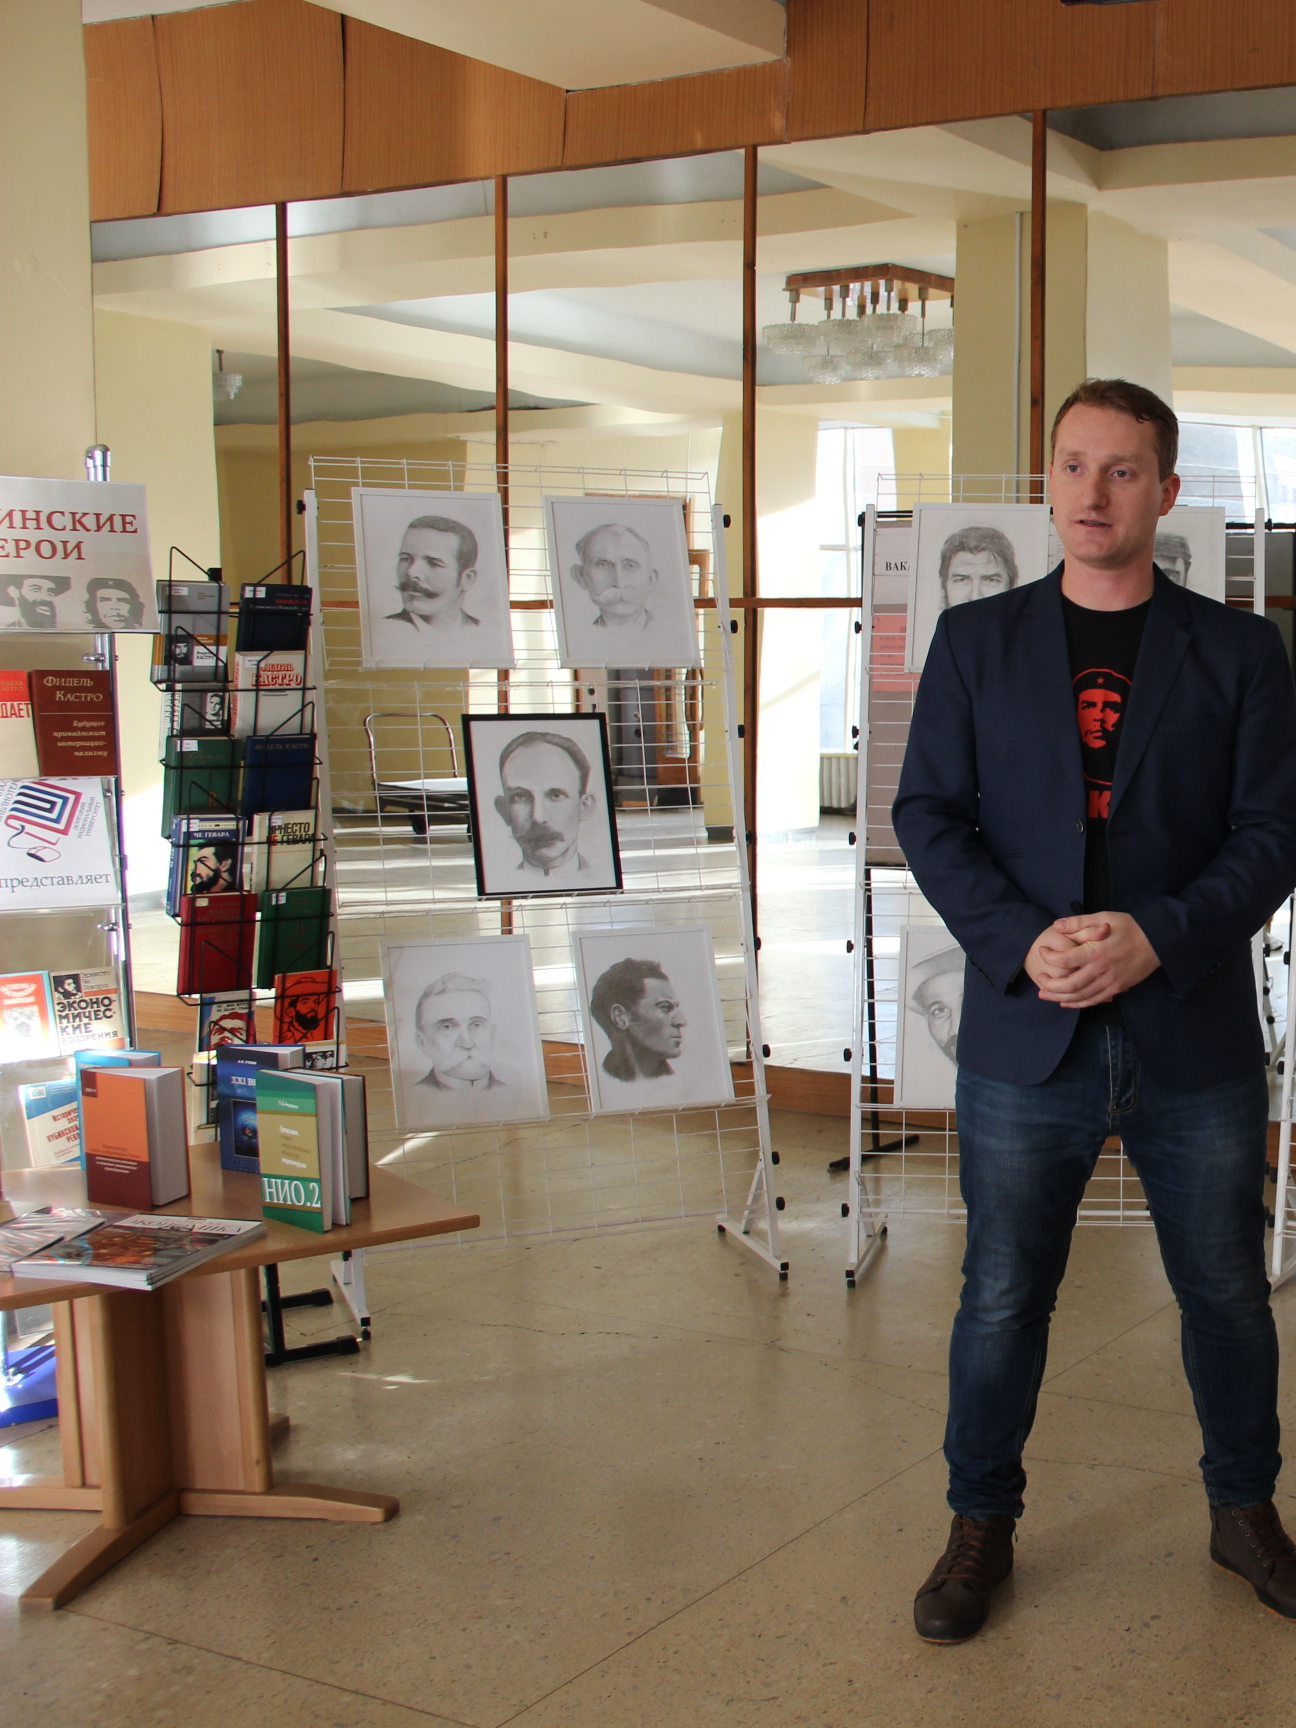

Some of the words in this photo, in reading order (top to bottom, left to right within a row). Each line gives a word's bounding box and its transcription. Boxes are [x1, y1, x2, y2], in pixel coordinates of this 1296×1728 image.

[43, 676, 94, 687] ФИДЕЛЬ
[56, 690, 103, 702] КАСТРО
[0, 703, 31, 718] ДАЕТ
[0, 873, 111, 894] представляет
[56, 996, 116, 1013] ЭКОНО-
[58, 1008, 116, 1024] МИЧЕС-
[59, 1022, 93, 1036] КИЕ
[62, 1030, 118, 1044] ВОЗЗРЕНИЯ
[262, 1177, 322, 1208] НИО.2
